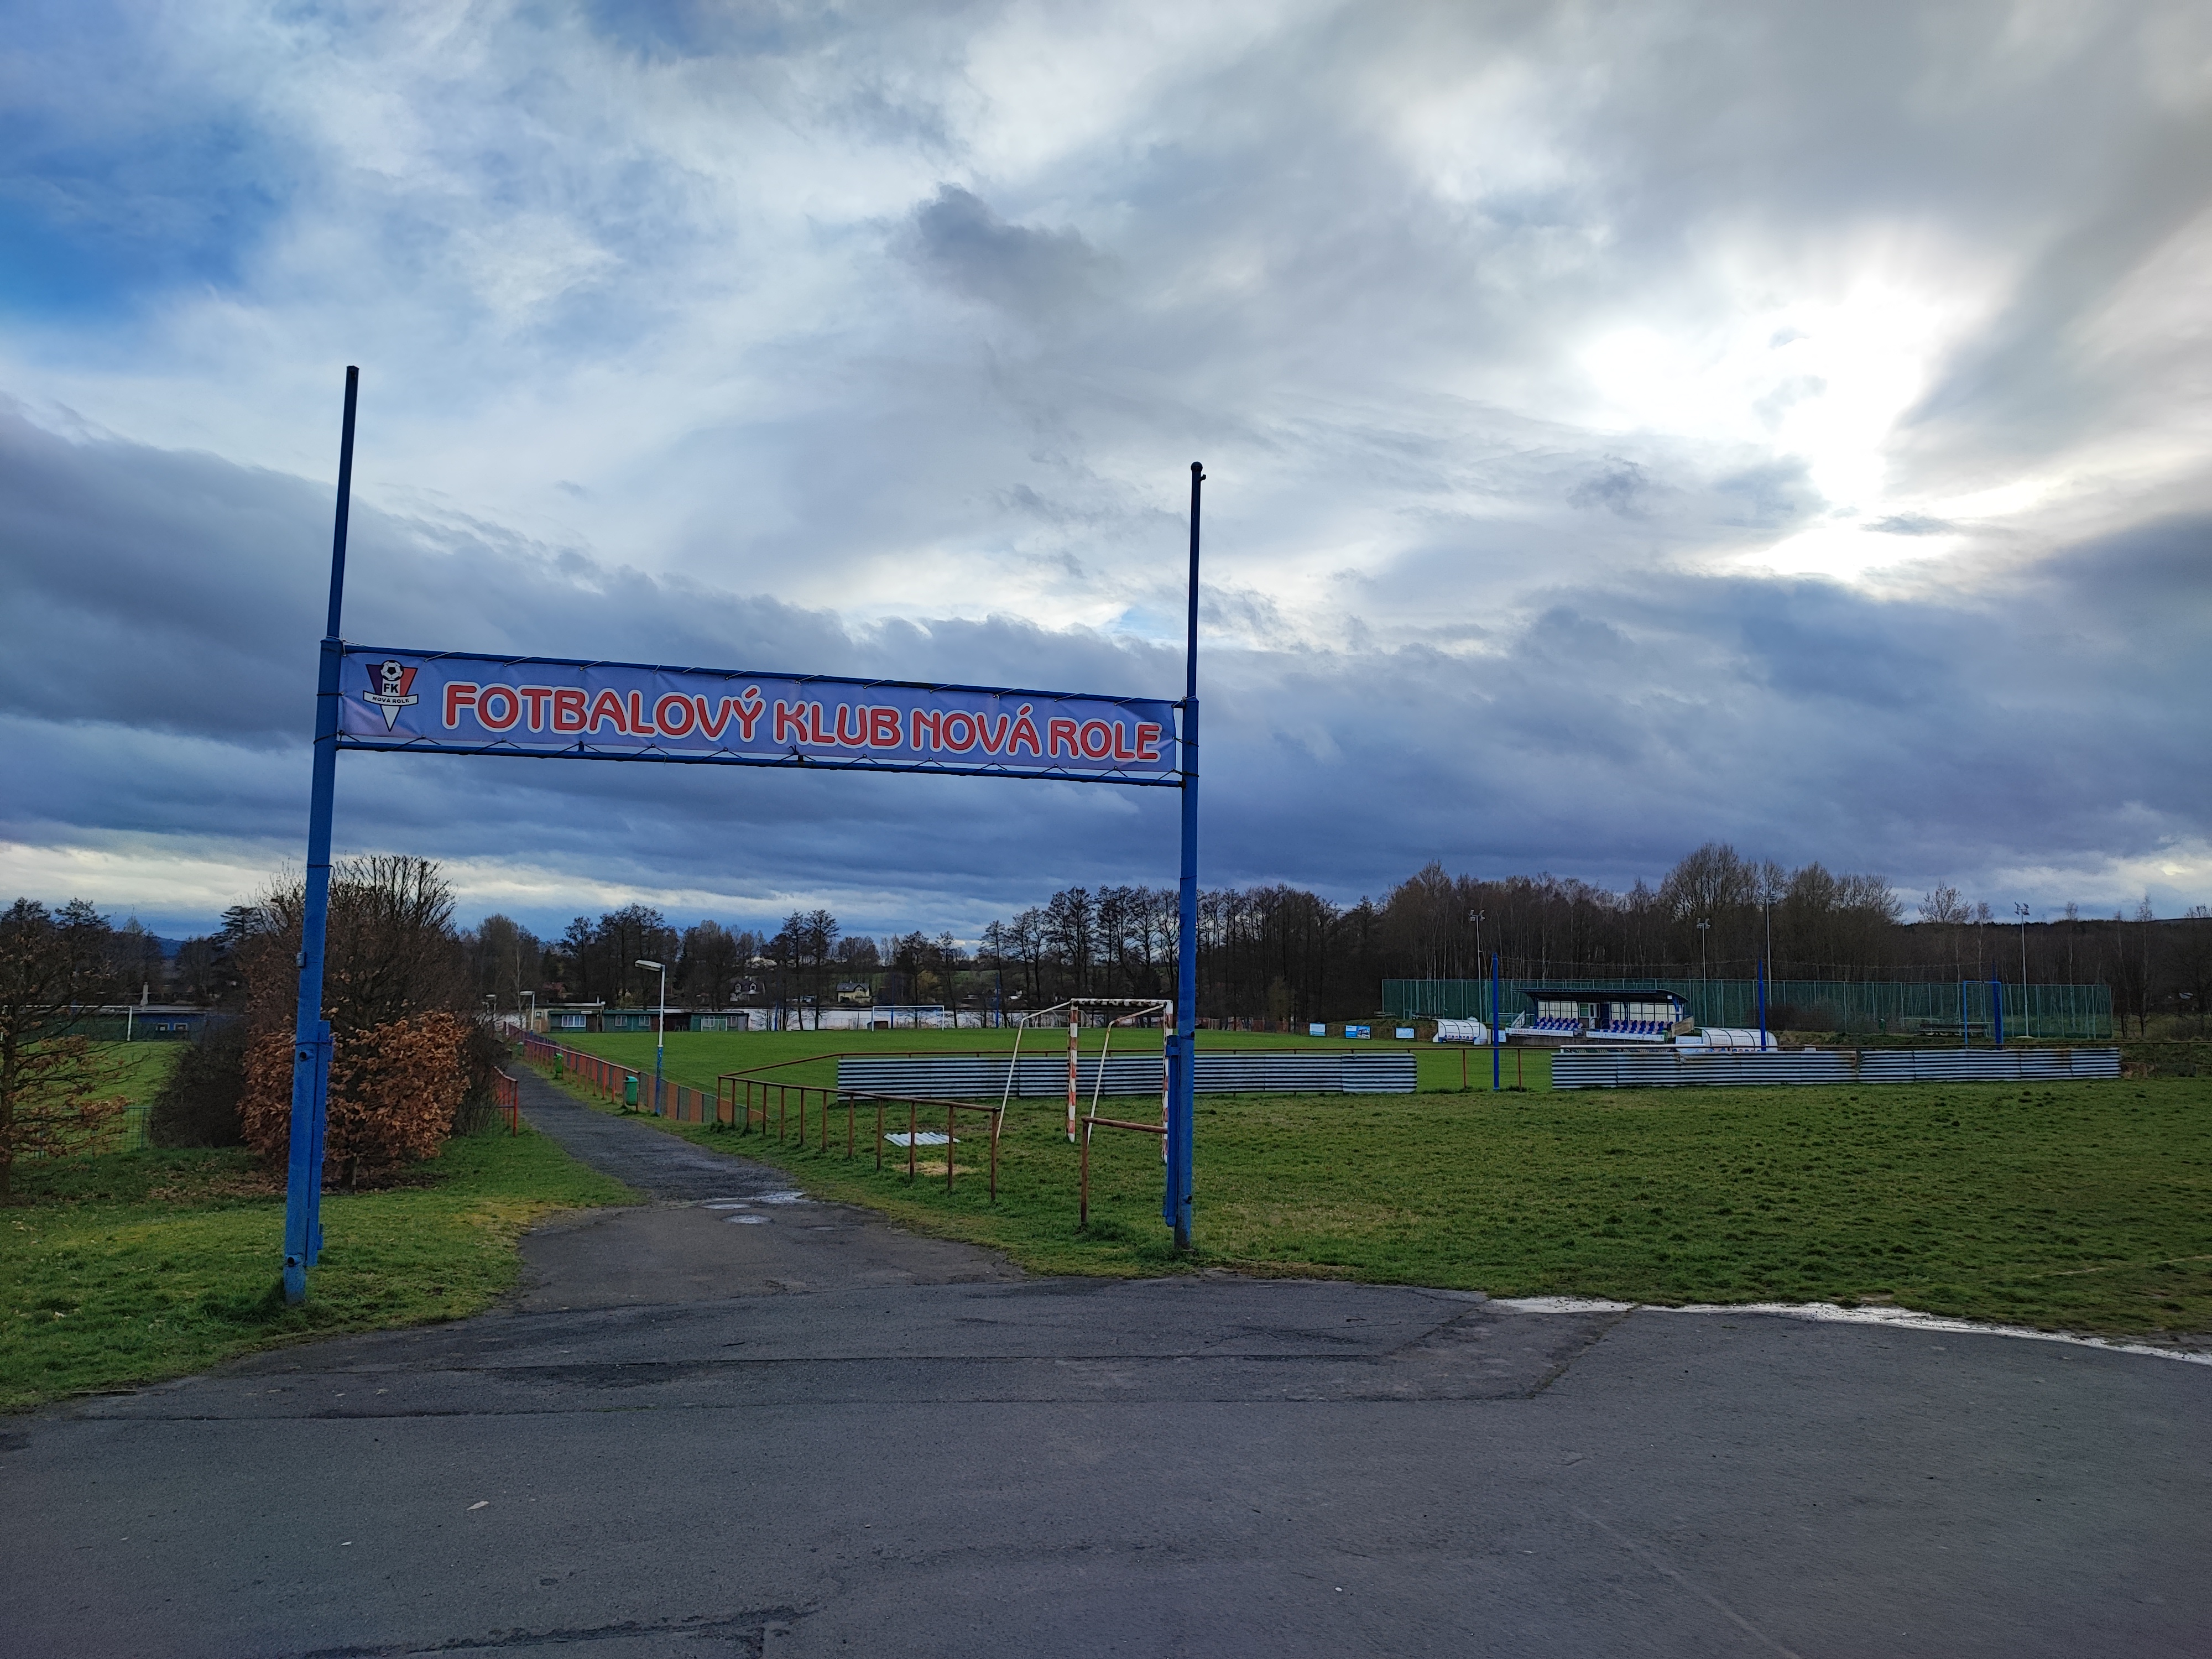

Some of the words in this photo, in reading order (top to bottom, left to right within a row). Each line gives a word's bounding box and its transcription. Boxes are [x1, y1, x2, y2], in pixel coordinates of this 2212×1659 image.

[383, 683, 399, 693] FK
[445, 684, 764, 740] FOTBALOVÝ
[775, 701, 901, 747] KLUB
[911, 704, 1041, 754] NOVÁ
[1049, 718, 1161, 761] ROLE
